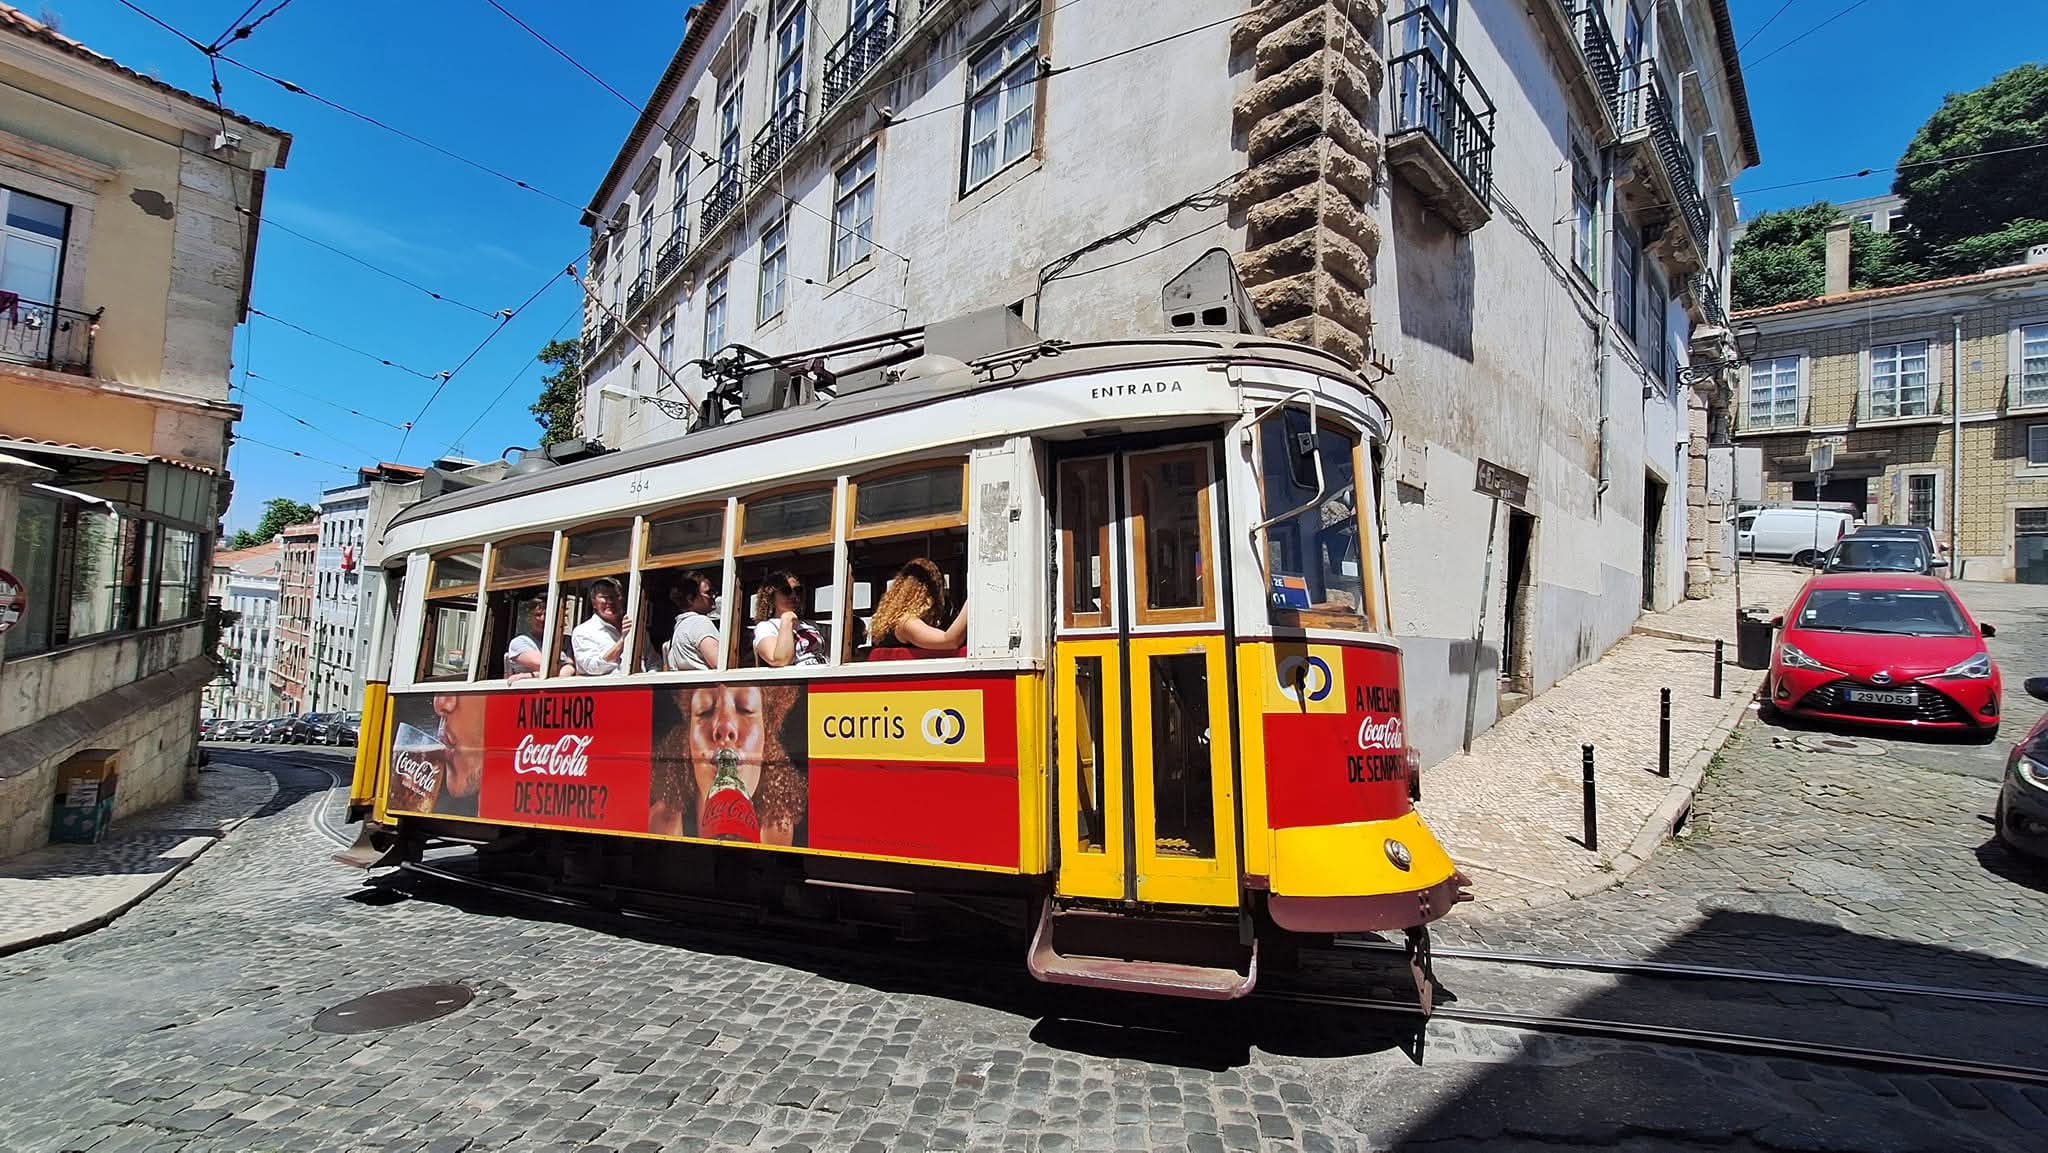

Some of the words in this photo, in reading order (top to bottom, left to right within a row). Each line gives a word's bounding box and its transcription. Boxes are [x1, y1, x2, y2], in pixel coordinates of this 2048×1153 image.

[1092, 381, 1182, 399] ENTRADA
[630, 480, 649, 494] 564
[1271, 578, 1284, 587] 2E
[517, 698, 527, 729] A
[530, 696, 594, 729] MELHOR
[1356, 685, 1365, 712] A
[823, 706, 905, 739] carris
[1358, 716, 1402, 749] Coca-Cola
[395, 751, 440, 793] Coca-Cola
[514, 734, 594, 777] Coca-Cola
[1347, 755, 1365, 783] DE
[514, 781, 533, 814] DE
[535, 782, 608, 819] SEMPRE?
